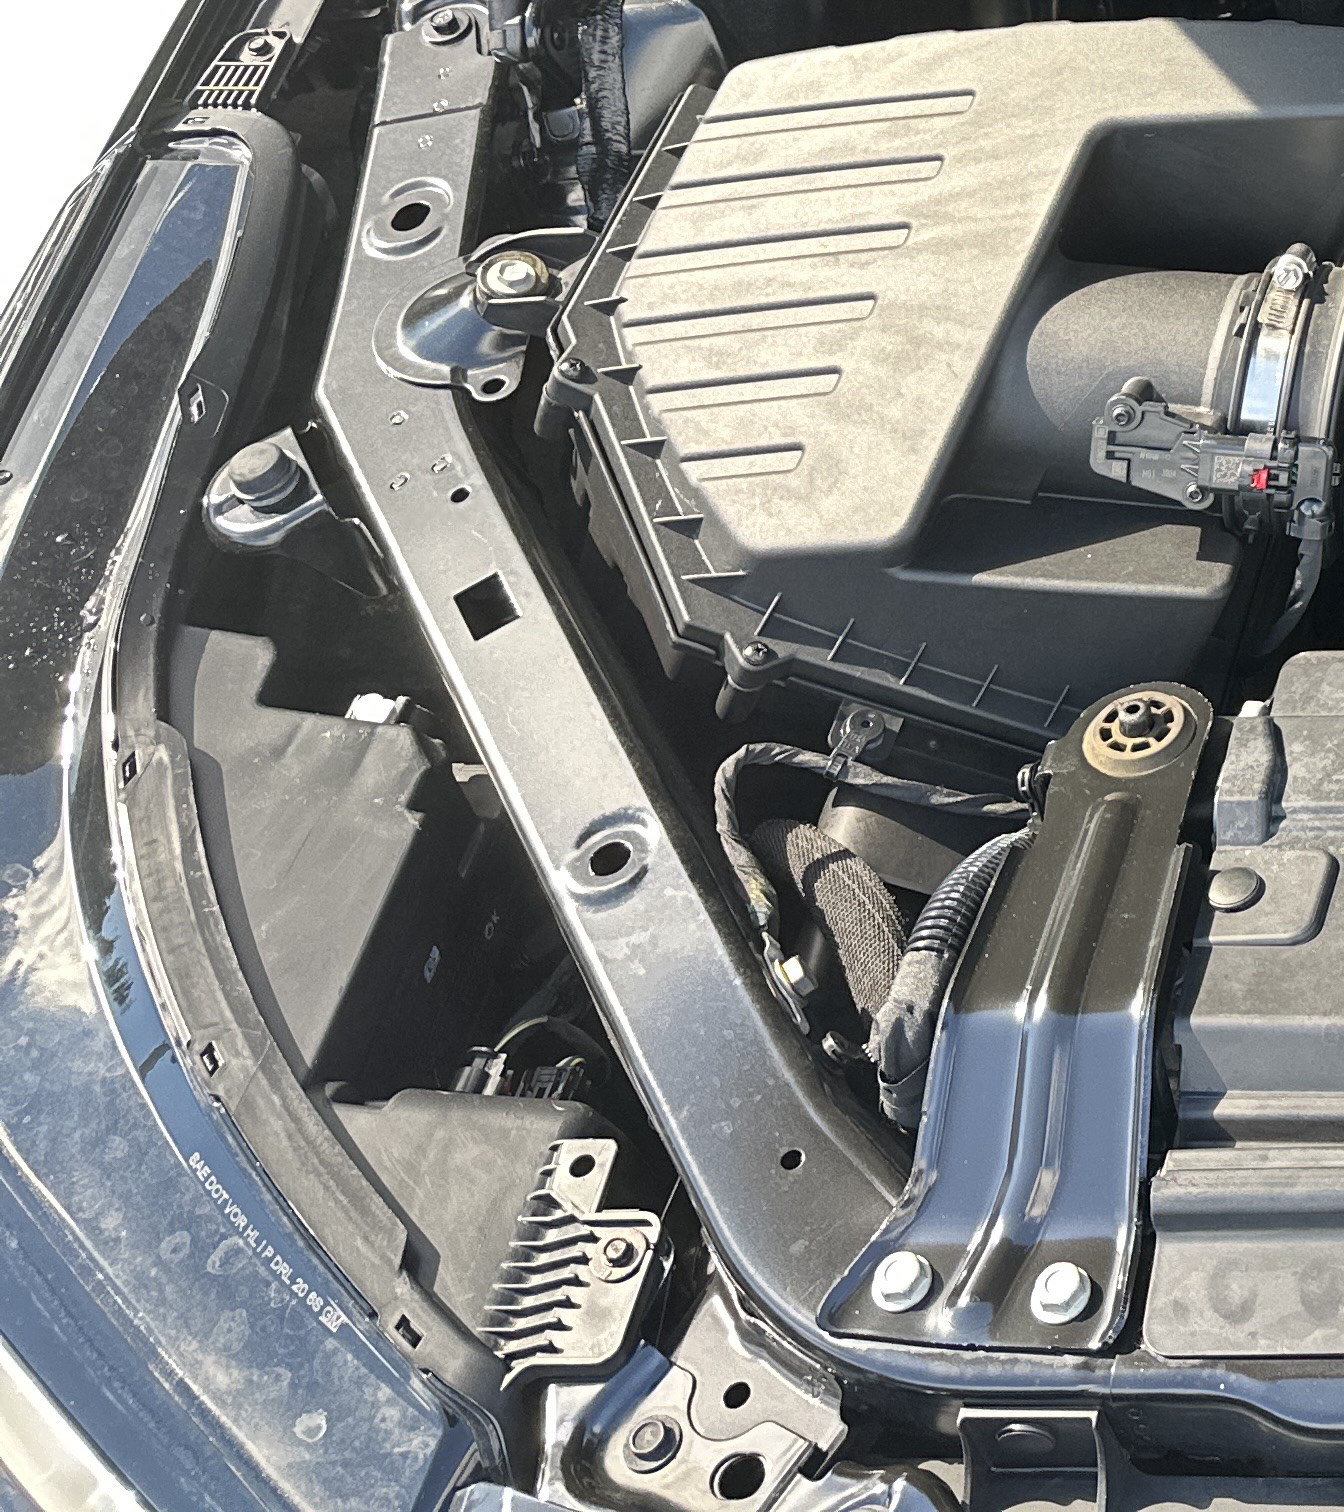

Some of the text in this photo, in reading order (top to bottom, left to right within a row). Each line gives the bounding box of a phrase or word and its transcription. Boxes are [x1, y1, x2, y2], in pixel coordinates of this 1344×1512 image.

[189, 1152, 211, 1181] SAE
[204, 1176, 230, 1205] DOT
[223, 1199, 248, 1232] VOR
[243, 1224, 260, 1248] HL
[261, 1245, 275, 1259] P
[270, 1254, 293, 1285] DRL
[291, 1277, 309, 1297] 20
[318, 1305, 345, 1333] GM
